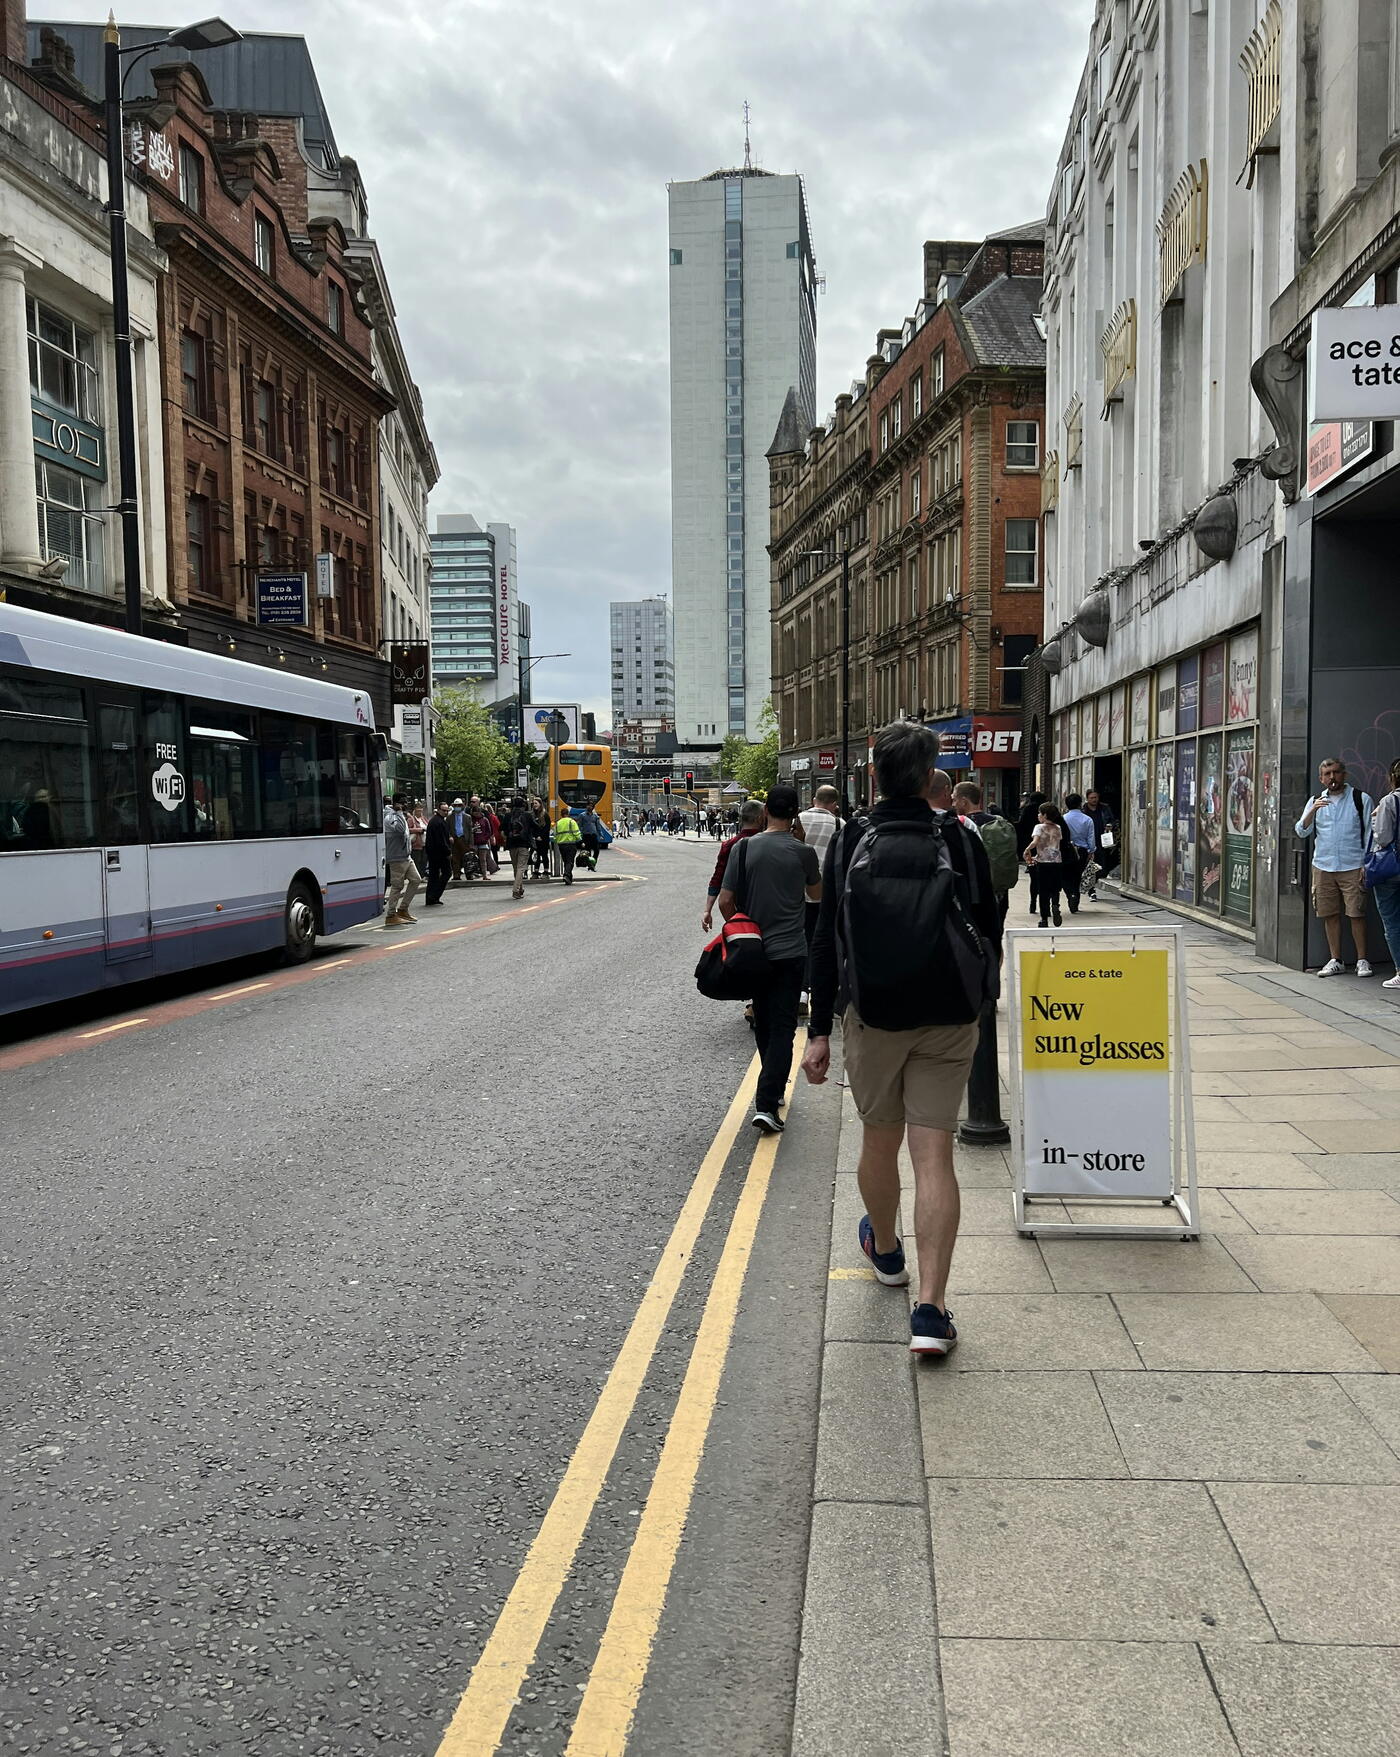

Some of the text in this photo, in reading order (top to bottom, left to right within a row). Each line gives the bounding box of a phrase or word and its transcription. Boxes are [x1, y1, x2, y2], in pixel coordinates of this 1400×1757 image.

[1329, 340, 1382, 360] ace
[500, 564, 508, 600] HOTEL
[156, 742, 177, 760] FREE
[975, 731, 1022, 752] BET
[1064, 969, 1123, 978] ace & tate
[1029, 994, 1085, 1021] New
[1042, 1138, 1146, 1172] in-store
